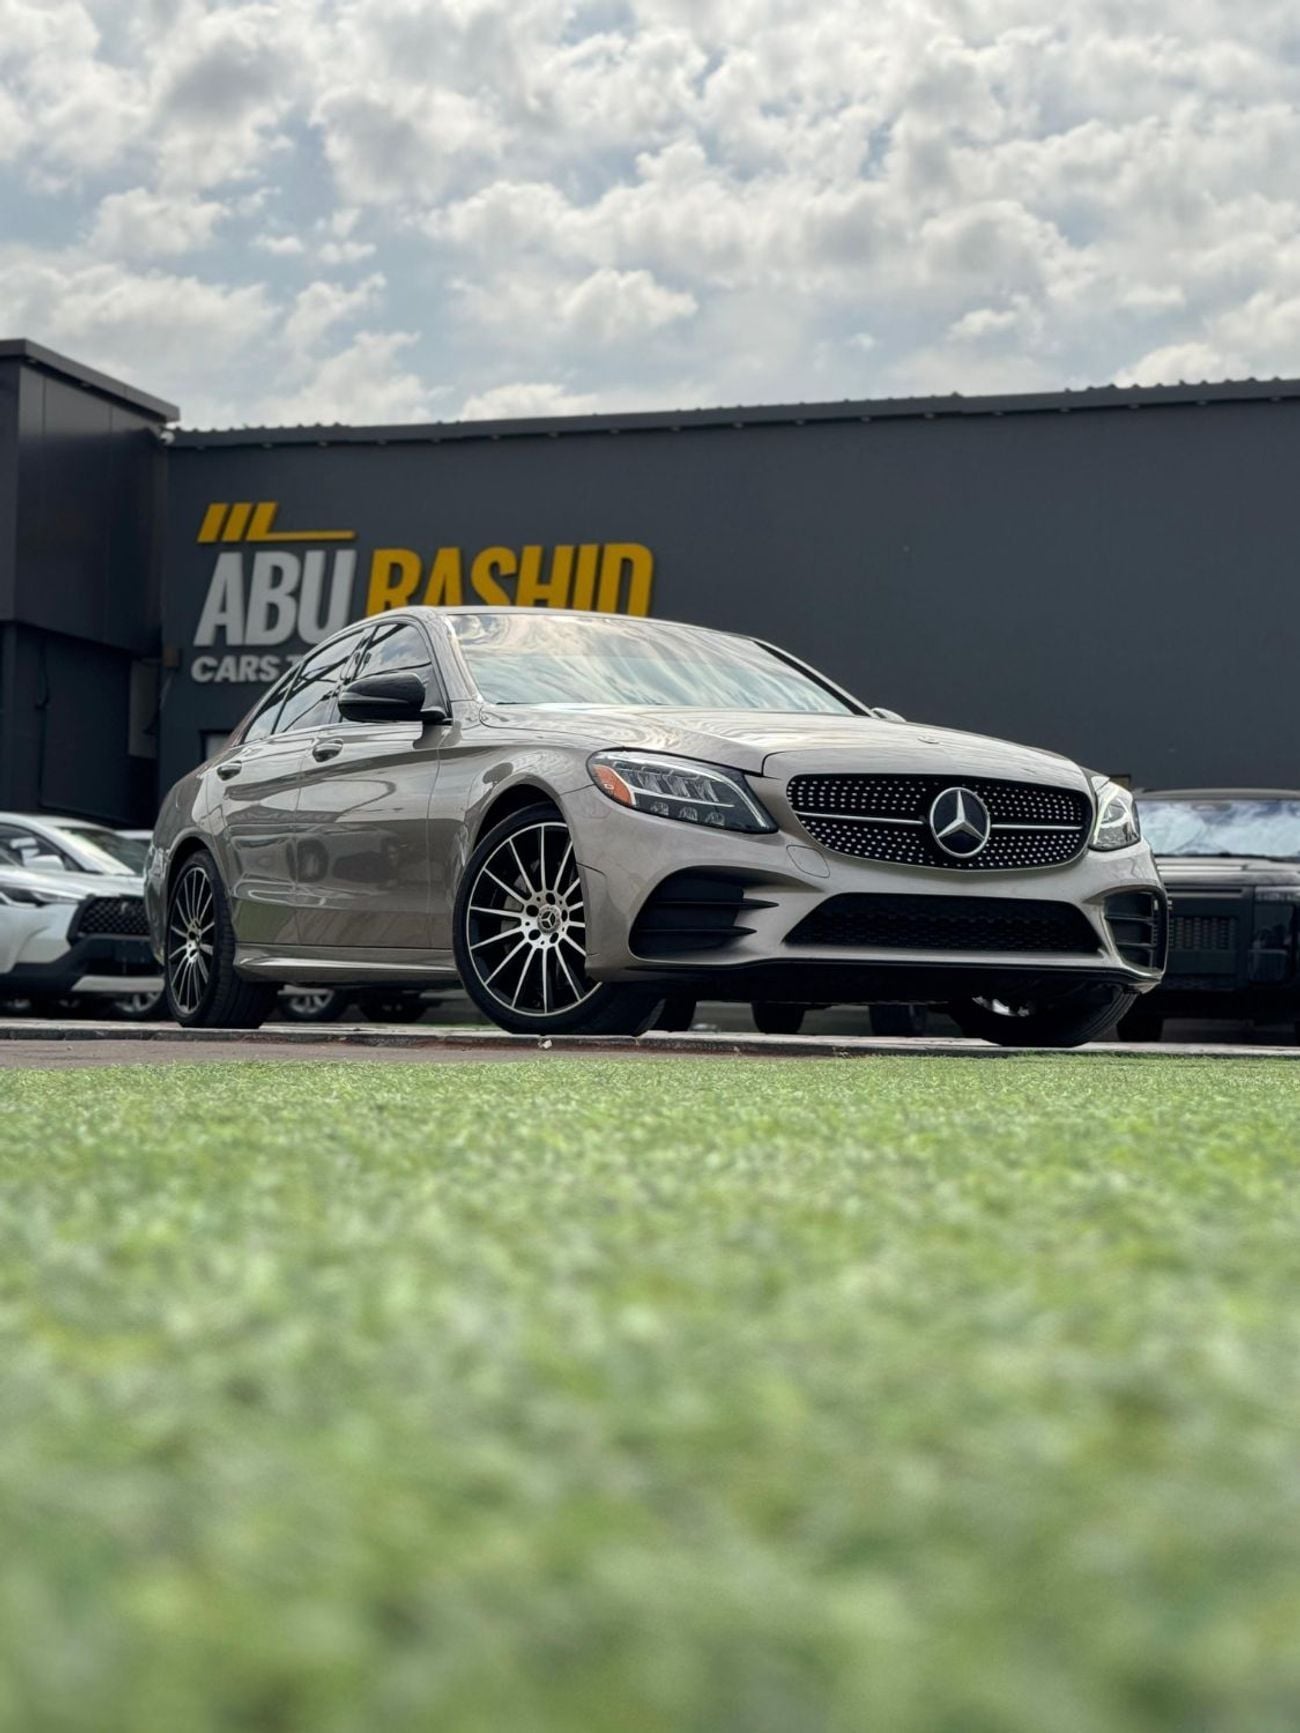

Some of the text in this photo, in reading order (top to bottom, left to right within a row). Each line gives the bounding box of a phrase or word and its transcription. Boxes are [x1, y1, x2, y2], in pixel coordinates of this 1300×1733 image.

[193, 543, 654, 647] ABU RASHID
[190, 654, 281, 683] CARS
